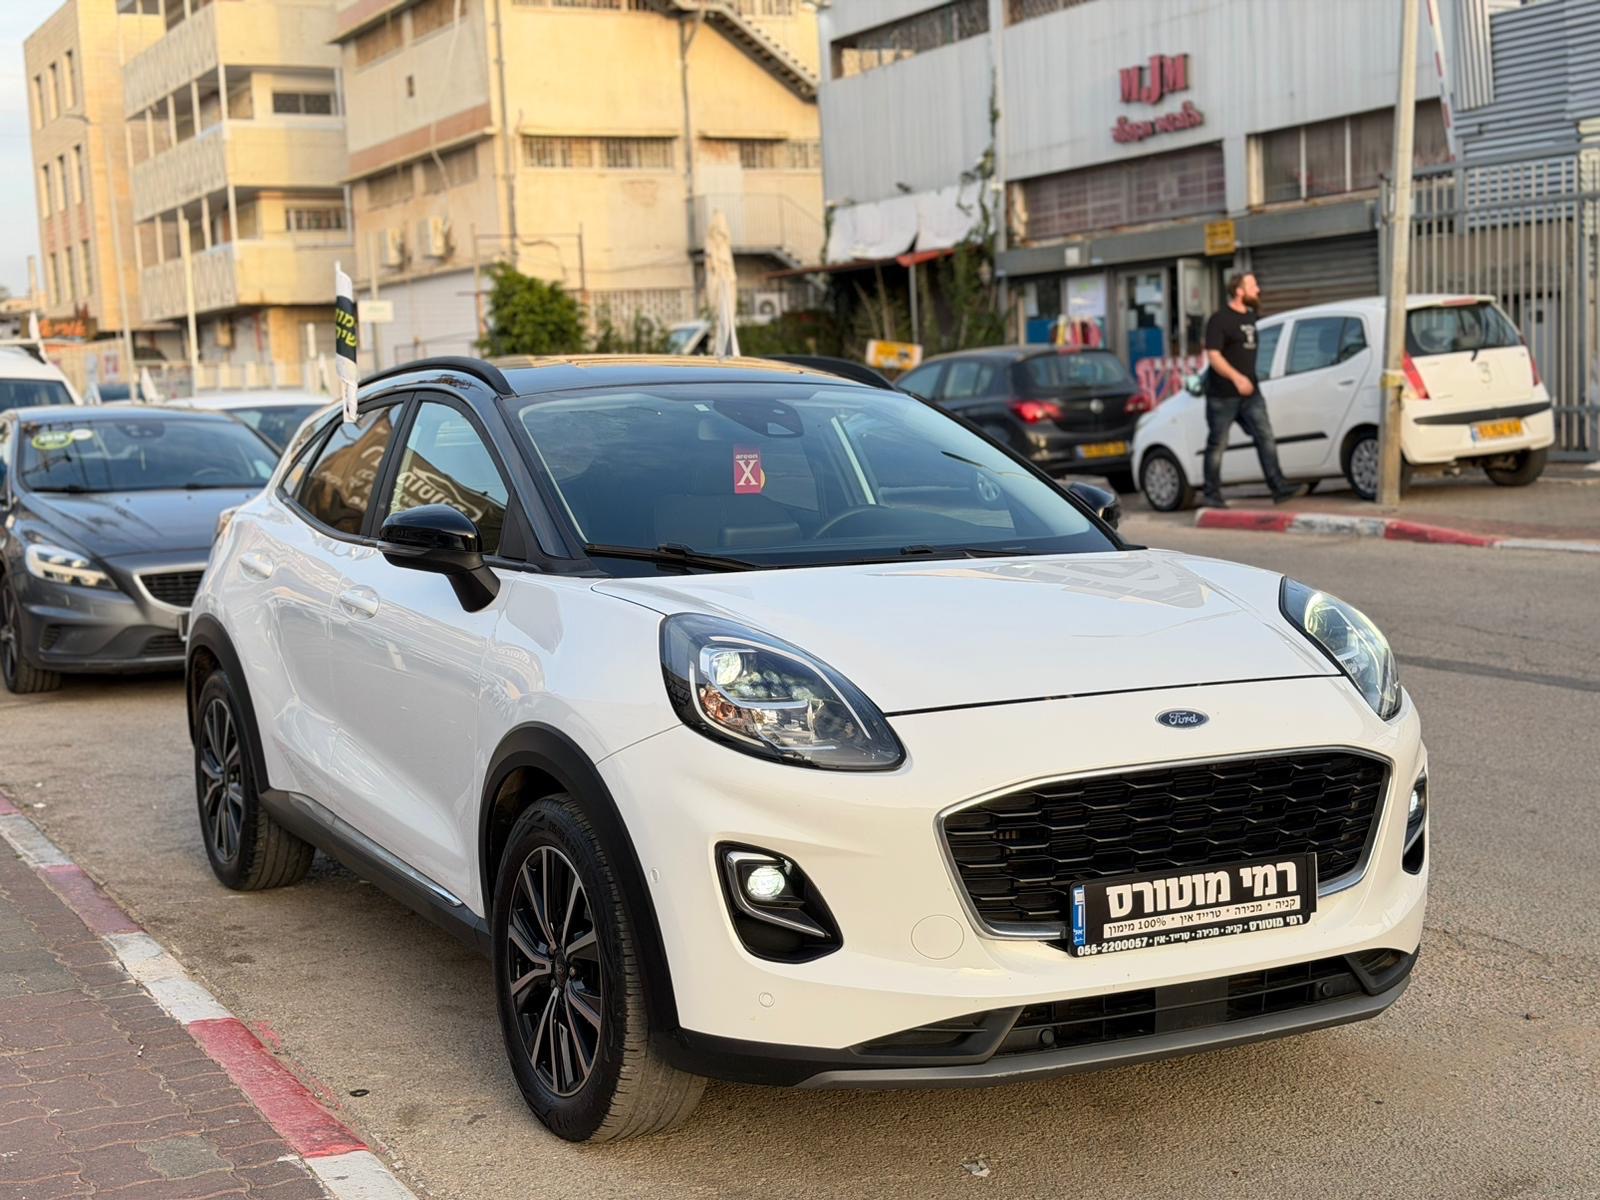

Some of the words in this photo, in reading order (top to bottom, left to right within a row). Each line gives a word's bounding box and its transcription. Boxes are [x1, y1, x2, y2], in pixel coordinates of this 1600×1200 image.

[736, 460, 759, 486] X
[1169, 711, 1198, 725] Ford
[1239, 861, 1297, 898] רמי
[1106, 871, 1230, 918] מוטורס
[1234, 903, 1262, 915] מכירה
[1275, 898, 1296, 909] קניה
[1179, 914, 1194, 926] אין
[1196, 909, 1221, 921] טרייד
[1286, 914, 1303, 925] רמי
[1108, 922, 1135, 937] מימון
[1138, 917, 1167, 930] 100%
[1225, 923, 1243, 934] קניה
[1249, 917, 1284, 931] מוטורס
[1196, 927, 1219, 938] מכירה
[1077, 937, 1148, 956] 055-2200057
